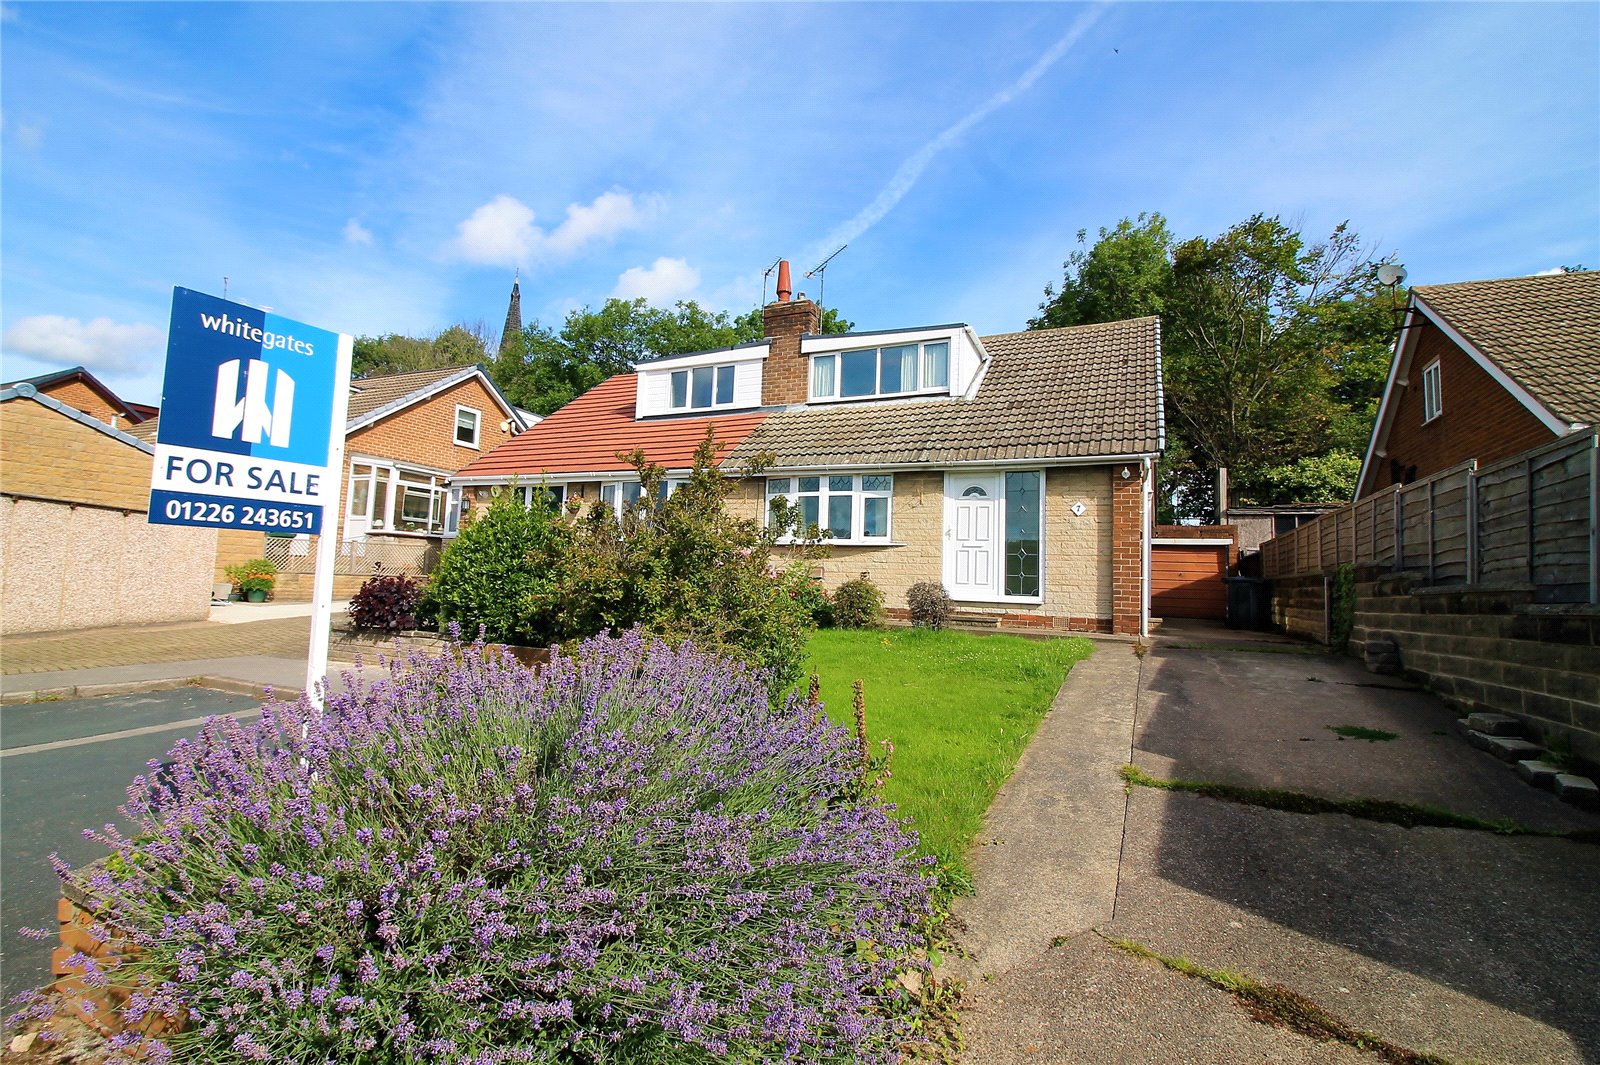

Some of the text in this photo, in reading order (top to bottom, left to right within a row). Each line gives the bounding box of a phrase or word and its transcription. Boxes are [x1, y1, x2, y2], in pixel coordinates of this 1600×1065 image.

[201, 313, 314, 355] whitegates
[166, 456, 320, 496] FOR SALE
[166, 499, 313, 528] 01226 243651
